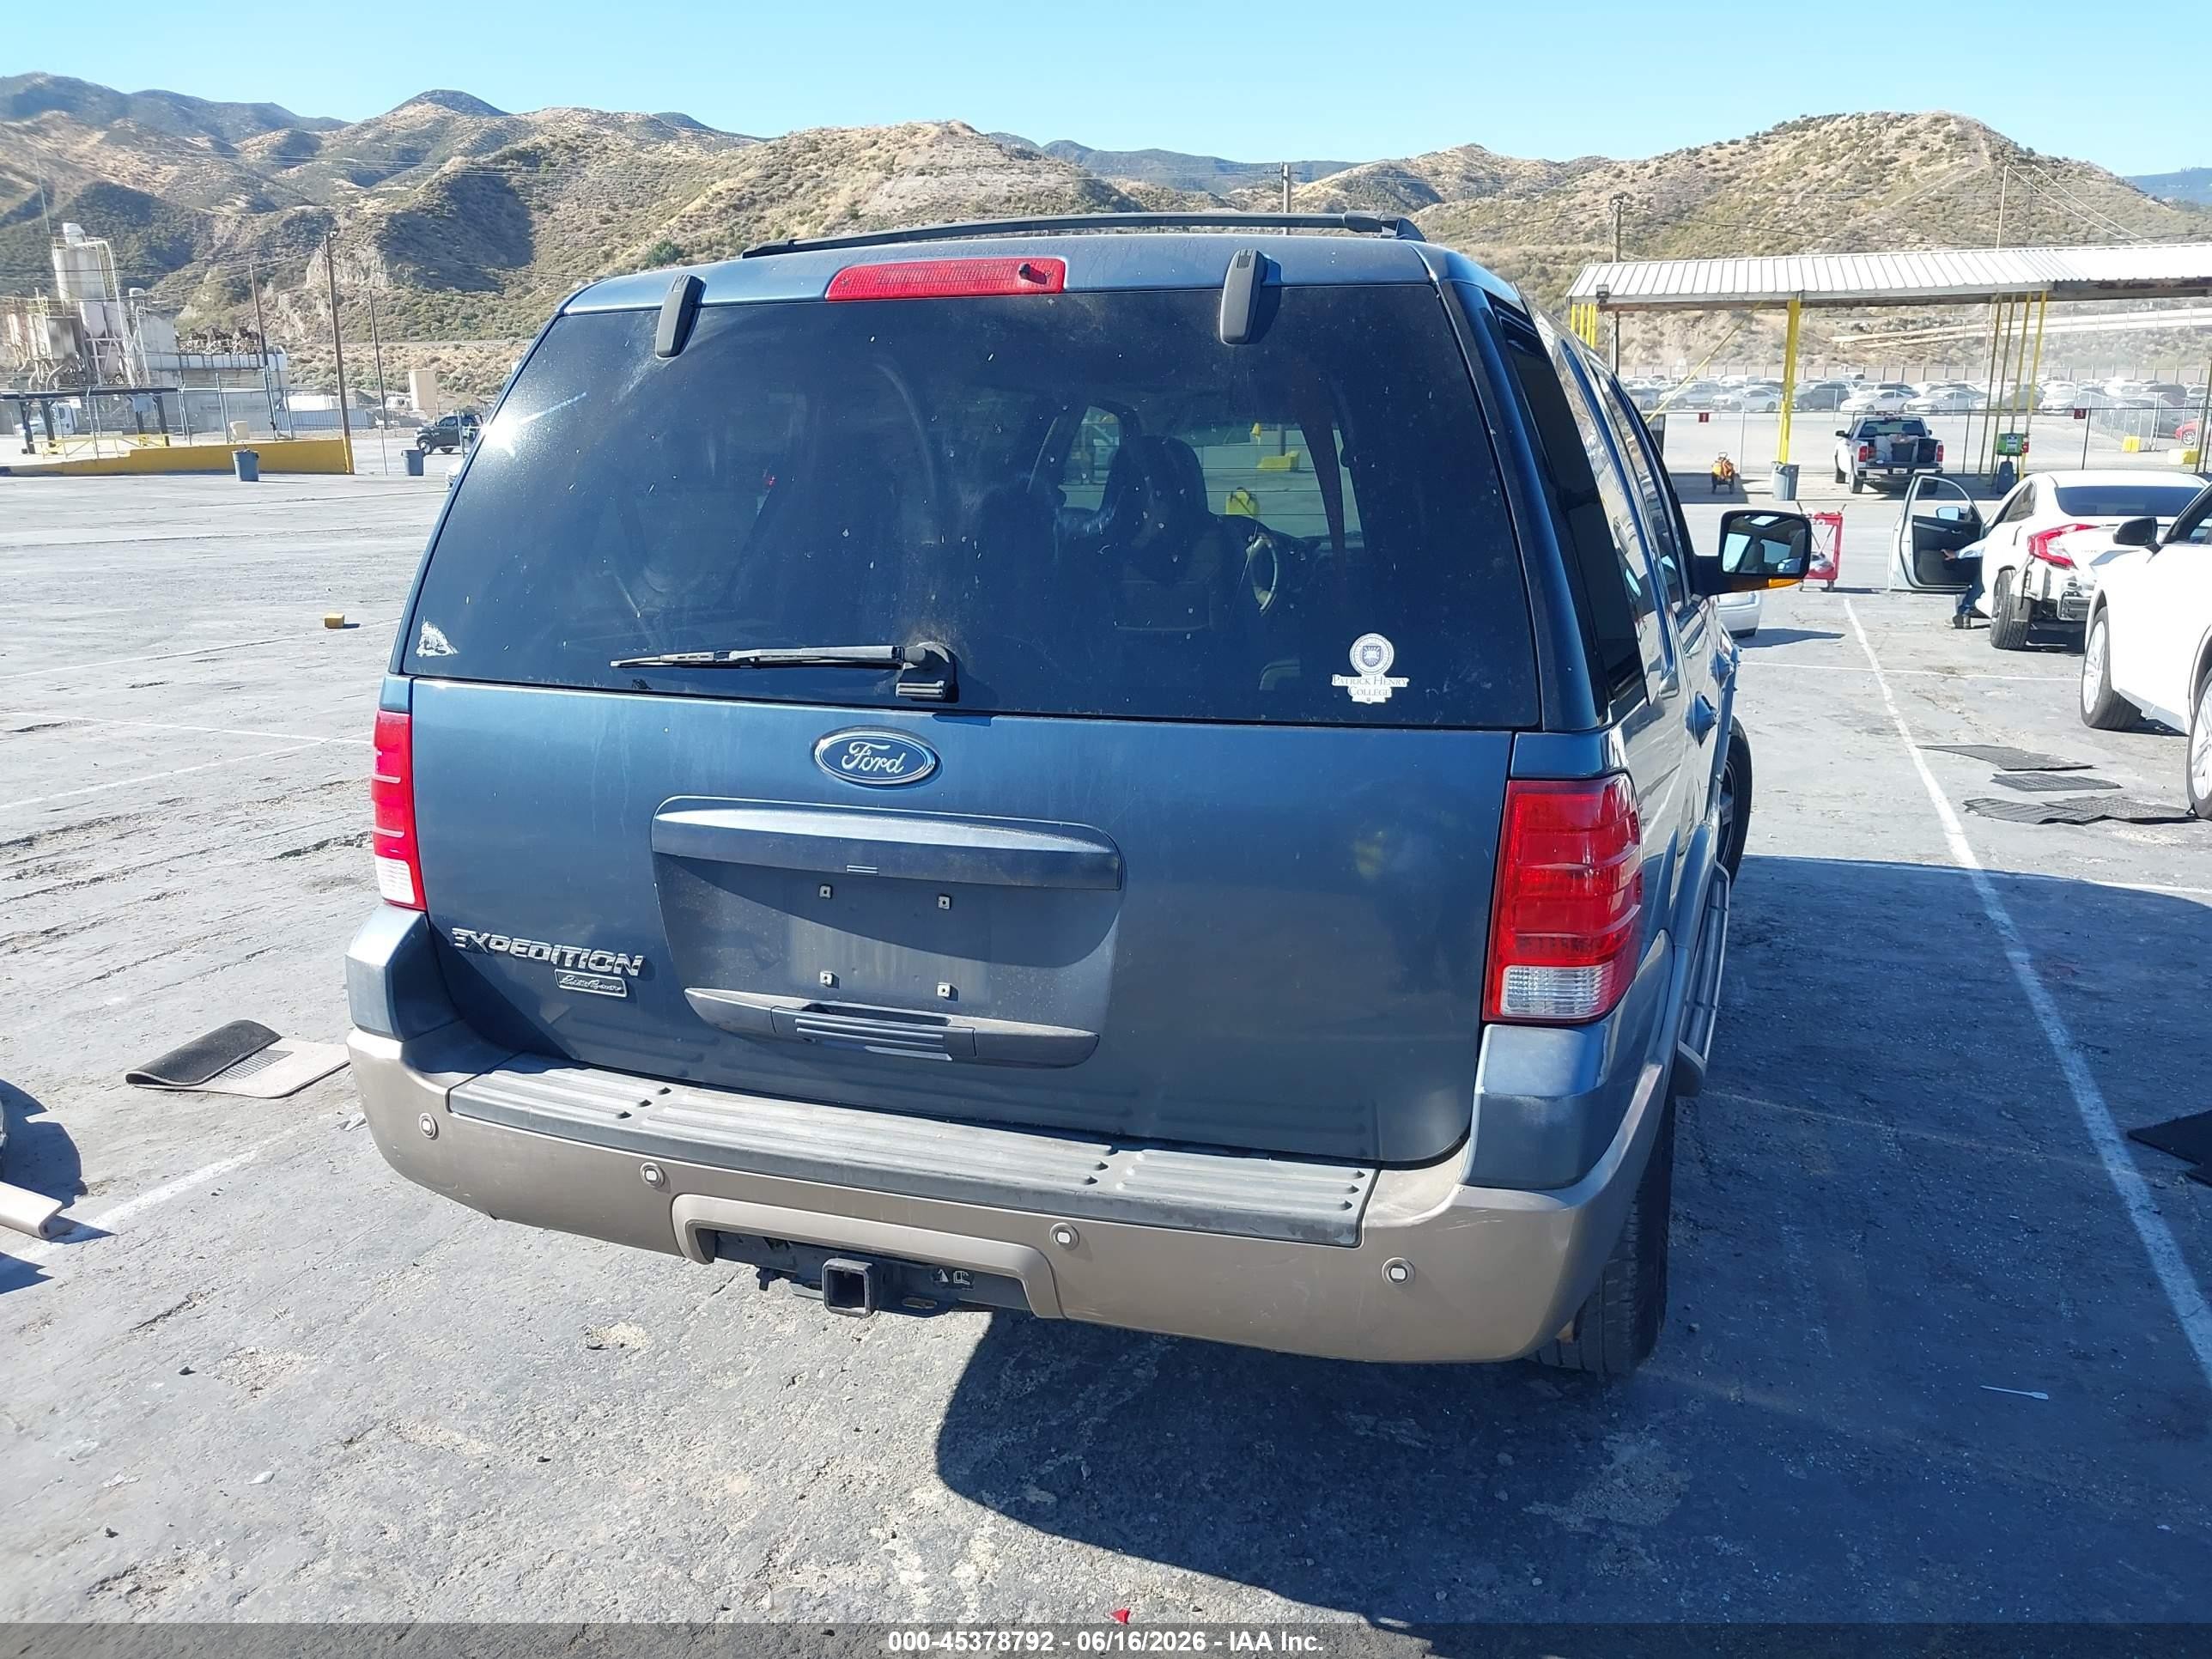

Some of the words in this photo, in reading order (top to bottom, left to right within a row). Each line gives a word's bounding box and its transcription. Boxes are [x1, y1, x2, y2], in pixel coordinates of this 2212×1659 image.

[1348, 686, 1391, 697] COLLEGE
[1373, 676, 1408, 687] HENRY
[841, 741, 907, 775] Ford
[451, 927, 647, 977] EXPEDITION
